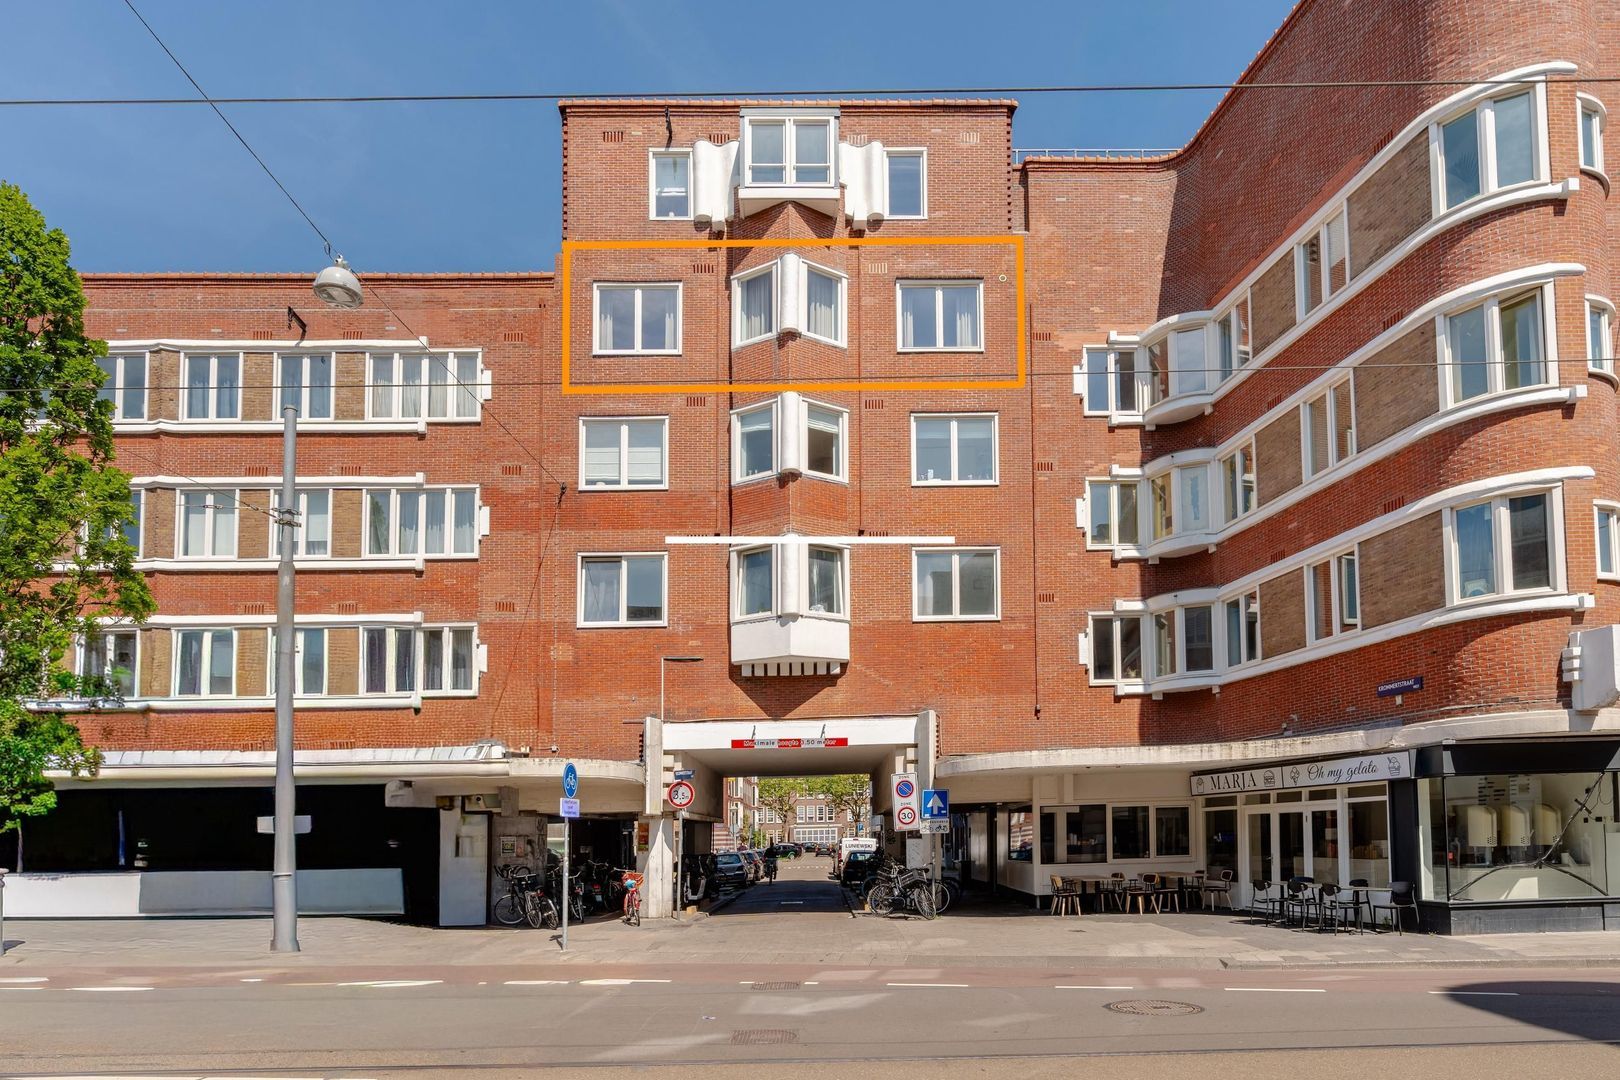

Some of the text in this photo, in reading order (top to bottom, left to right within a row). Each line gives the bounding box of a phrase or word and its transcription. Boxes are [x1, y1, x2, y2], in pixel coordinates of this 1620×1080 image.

[1307, 760, 1378, 782] Oh my gelato
[1210, 772, 1257, 791] MARJA
[901, 811, 912, 819] 30
